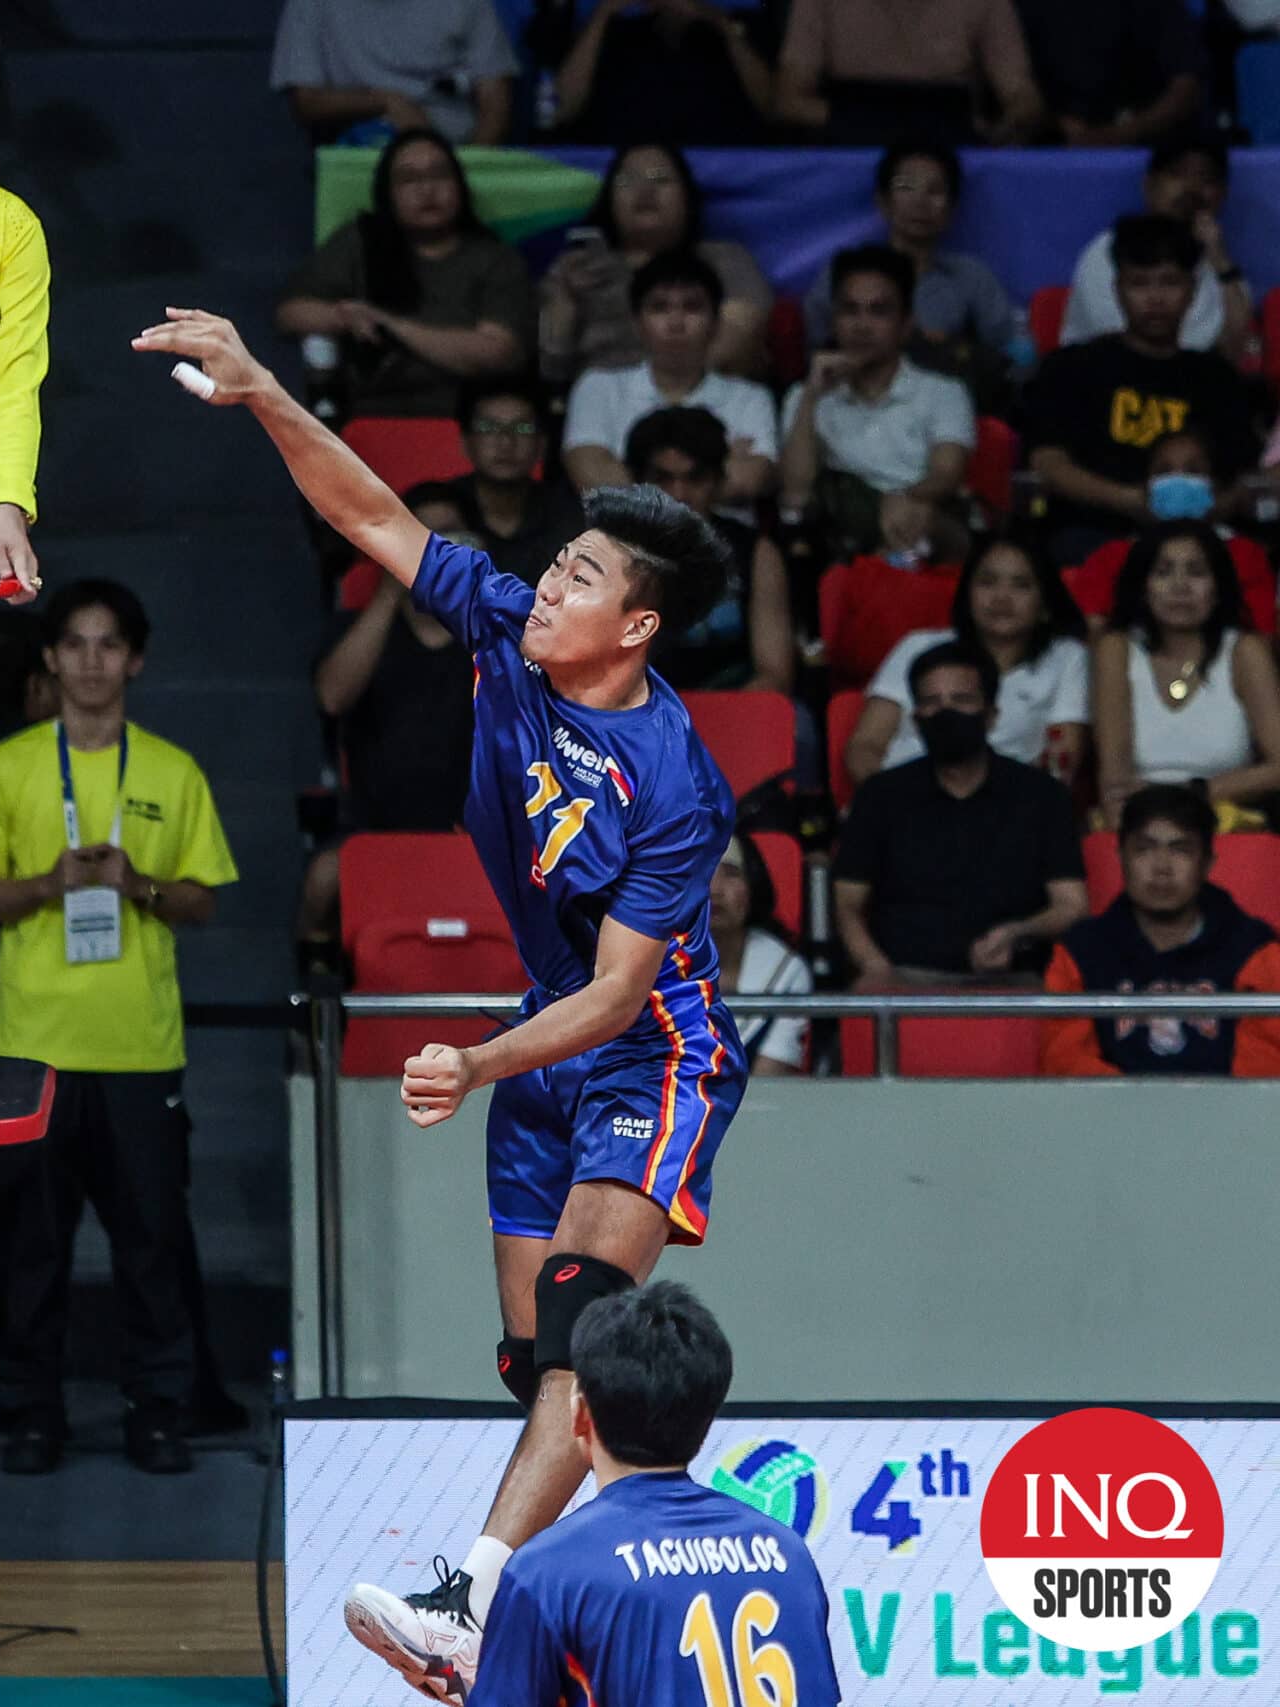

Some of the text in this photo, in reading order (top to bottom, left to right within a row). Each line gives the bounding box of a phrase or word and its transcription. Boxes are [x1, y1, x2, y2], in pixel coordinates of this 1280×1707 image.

[613, 1116, 654, 1129] GAME
[613, 1126, 652, 1139] VILLE
[851, 1449, 970, 1553] 4th
[615, 1534, 788, 1582] TAGUIBOLOS
[679, 1590, 798, 1707] 16
[843, 1588, 901, 1677] V
